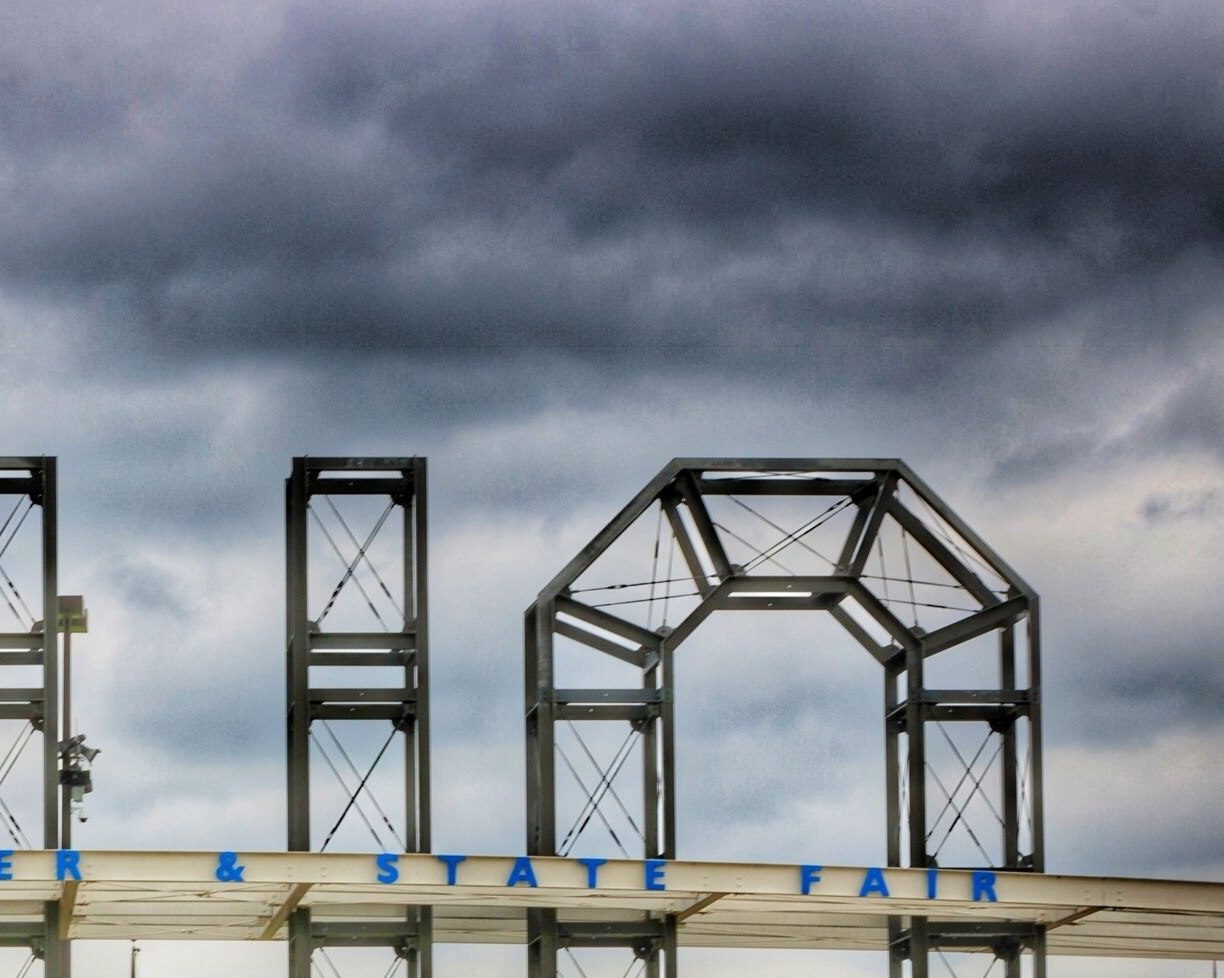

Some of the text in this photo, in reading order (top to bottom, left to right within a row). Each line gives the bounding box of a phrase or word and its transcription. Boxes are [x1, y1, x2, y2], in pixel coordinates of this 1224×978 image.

[215, 849, 245, 882] &
[376, 851, 666, 891] STATE
[800, 863, 998, 902] FAIR
